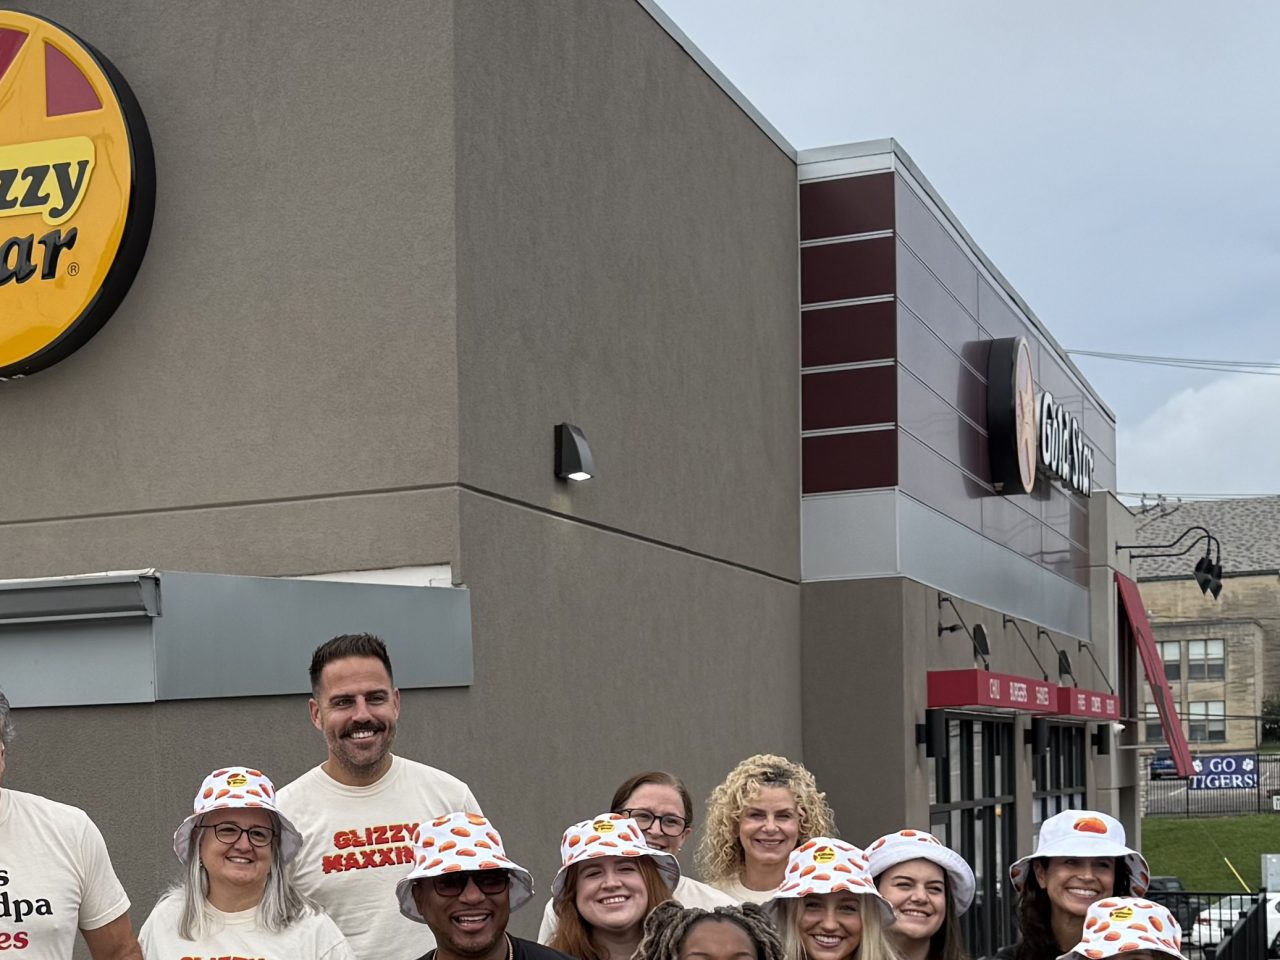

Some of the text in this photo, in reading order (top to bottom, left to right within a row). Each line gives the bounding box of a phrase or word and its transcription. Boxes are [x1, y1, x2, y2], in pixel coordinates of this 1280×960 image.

[1040, 391, 1094, 498] Gold Star
[1209, 758, 1236, 773] GO
[1189, 774, 1258, 789] TIGERS!
[333, 822, 420, 850] GLIZZY
[322, 846, 415, 874] MAXXIN
